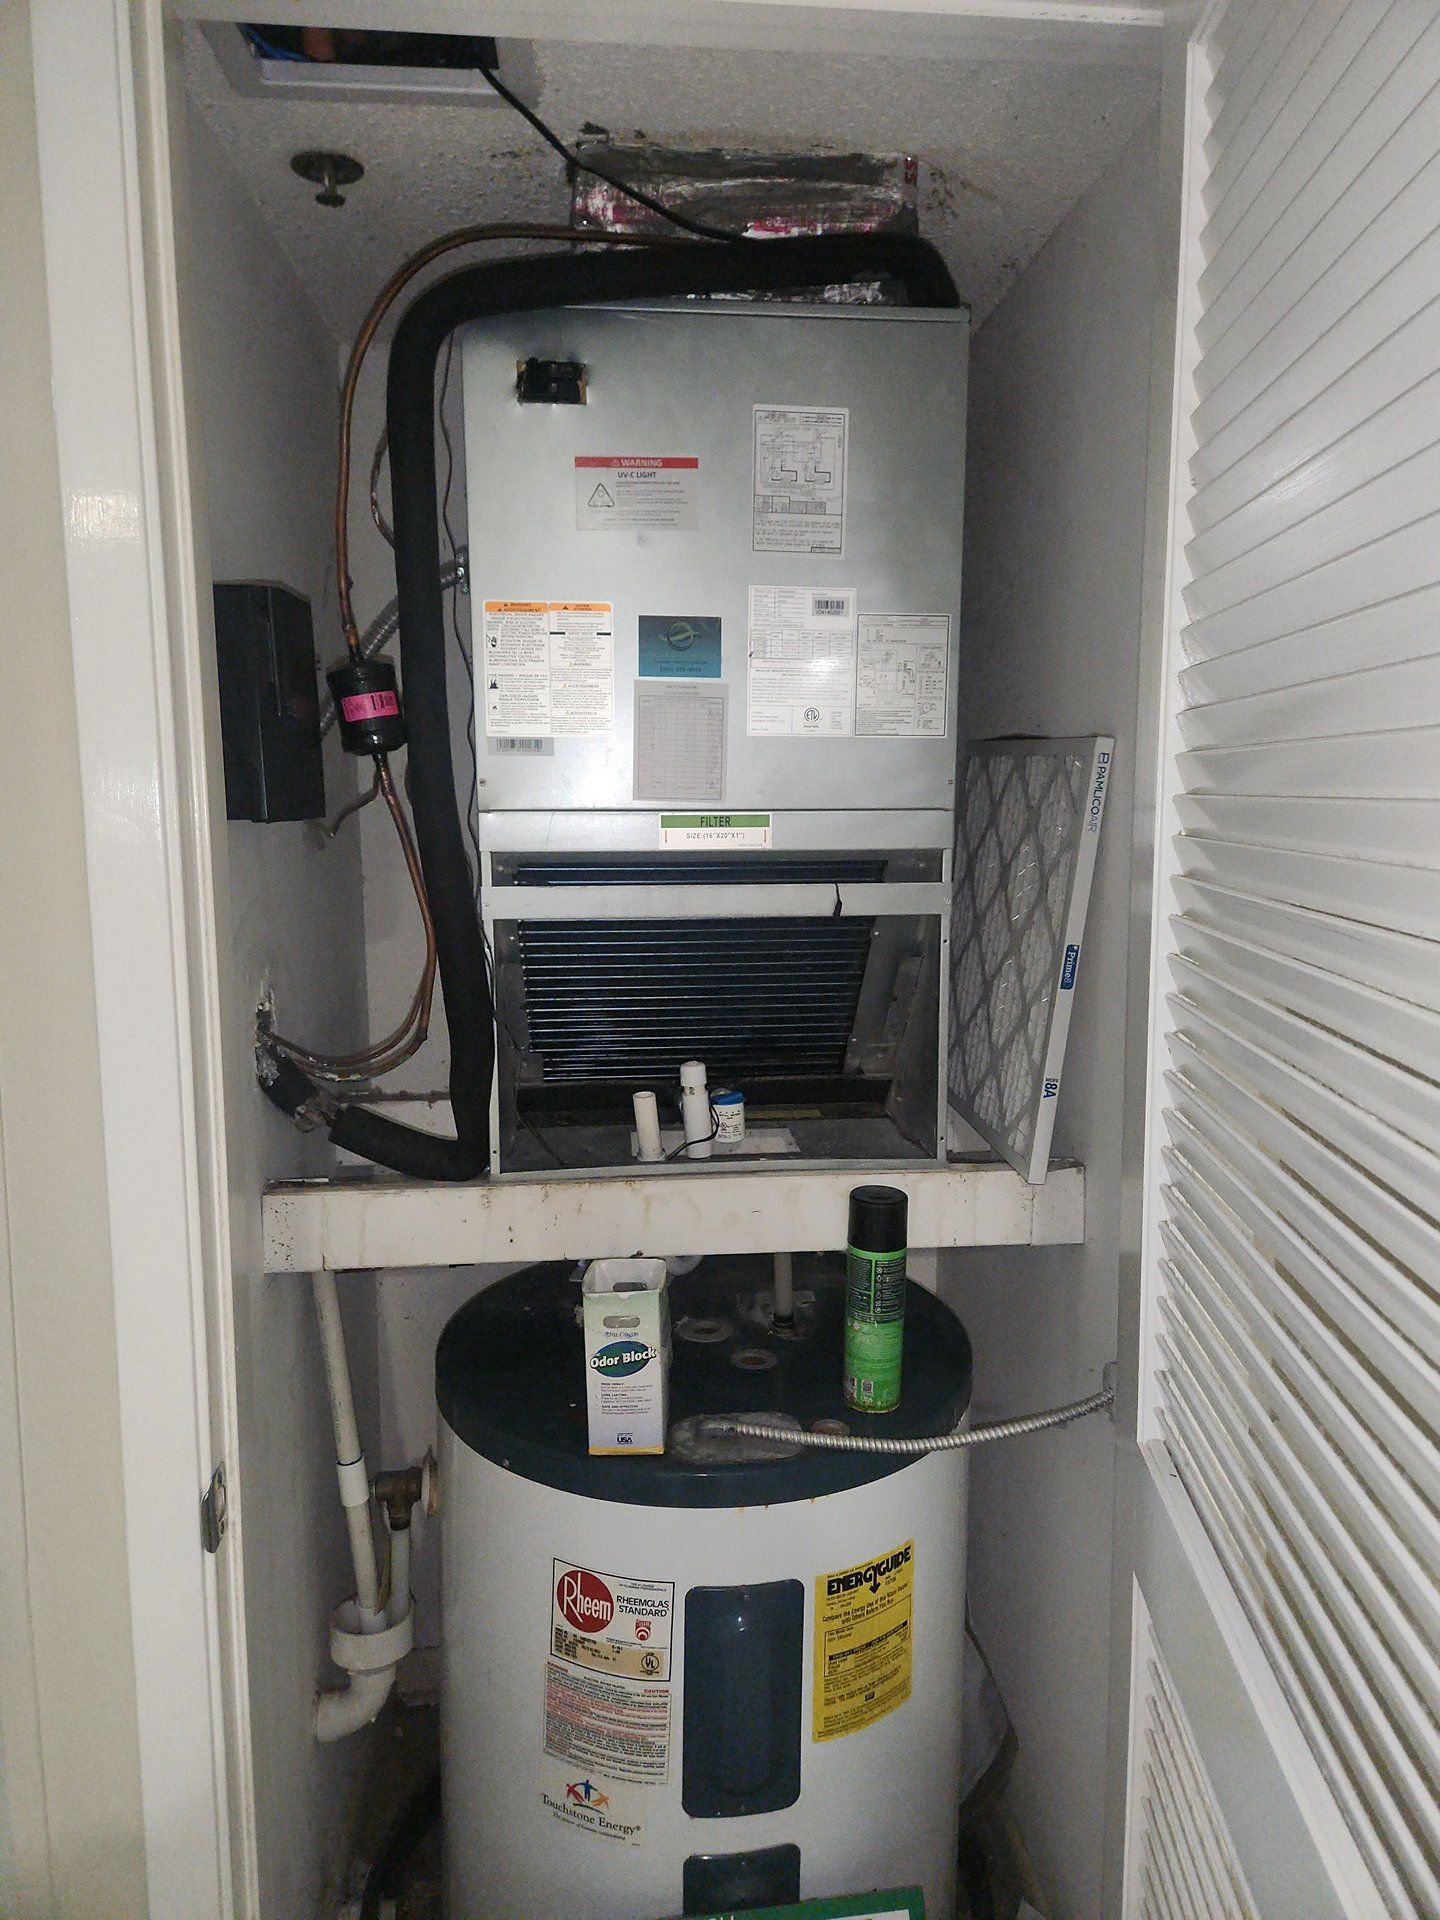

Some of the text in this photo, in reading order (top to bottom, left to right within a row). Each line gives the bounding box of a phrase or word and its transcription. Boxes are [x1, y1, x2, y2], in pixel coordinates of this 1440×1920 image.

[700, 816, 731, 827] FILTER
[1064, 951, 1076, 984] Prime8
[1043, 1083, 1058, 1098] 8A
[590, 1347, 656, 1368] Odor Block
[827, 1545, 912, 1594] ENERGYGUIDE
[563, 1572, 611, 1623] Rheem
[616, 1595, 670, 1608] RHEEMGLAS
[619, 1605, 668, 1618] STANDARD
[540, 1793, 595, 1824] Touchstone
